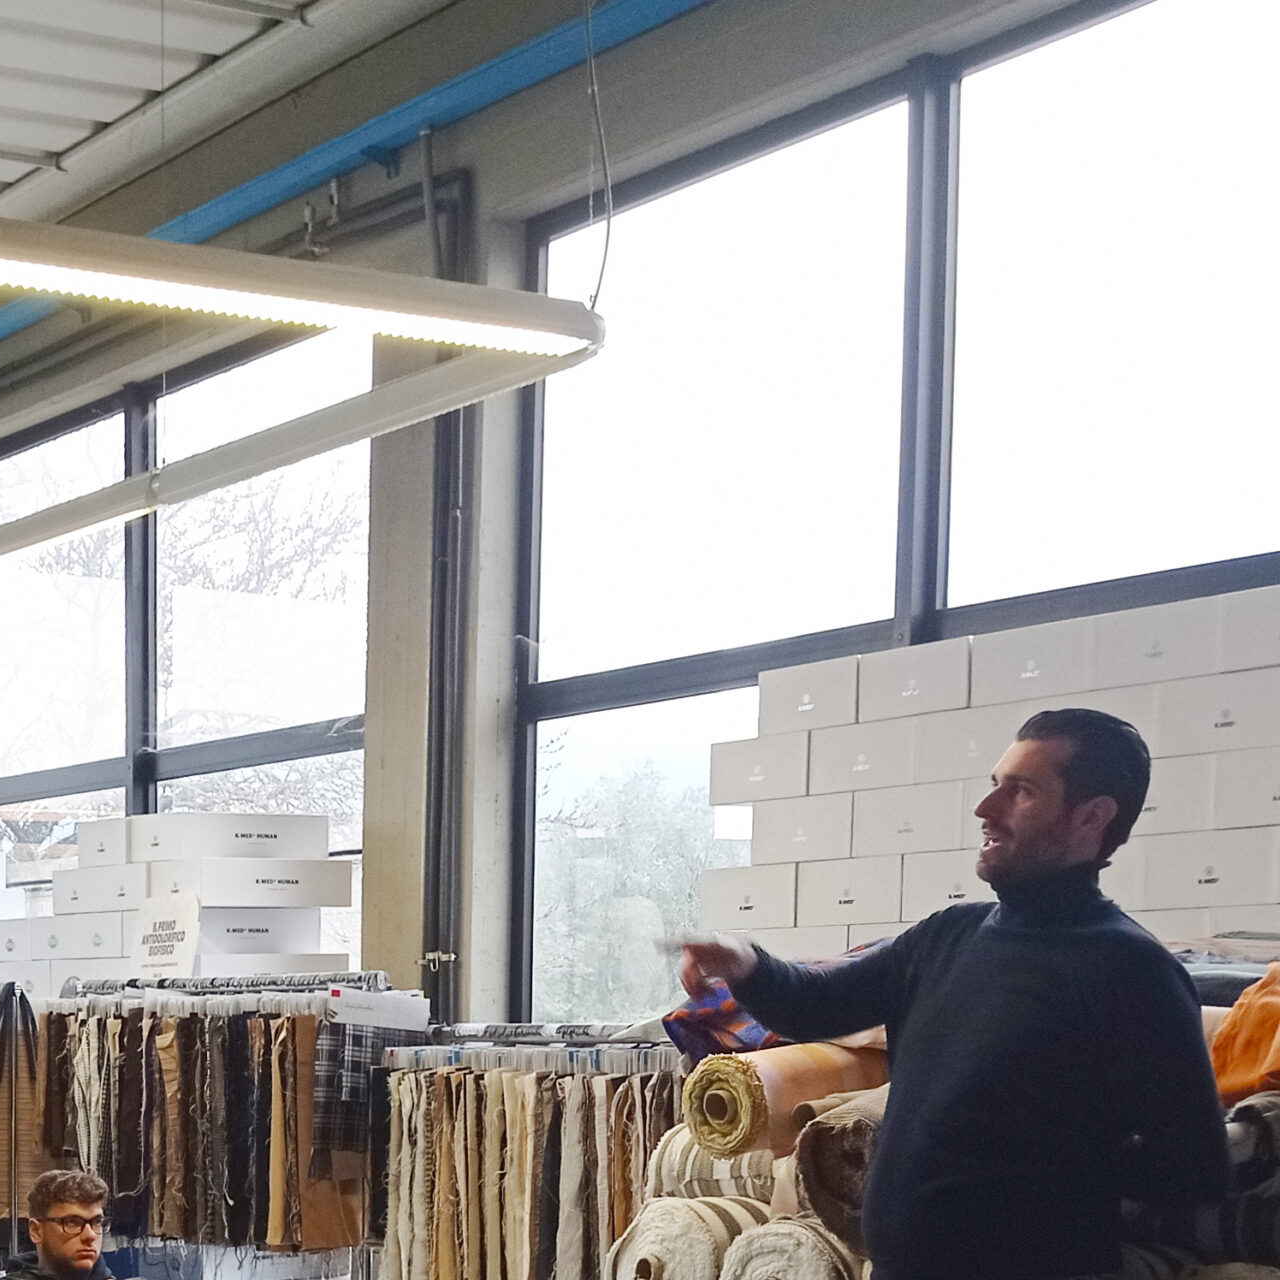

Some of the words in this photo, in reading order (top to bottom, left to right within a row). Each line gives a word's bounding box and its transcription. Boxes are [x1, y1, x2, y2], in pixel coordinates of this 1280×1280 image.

[158, 919, 176, 932] PRIMO
[141, 931, 186, 946] ANTIDOLORIFICO
[148, 944, 175, 957] BIOFISICO
